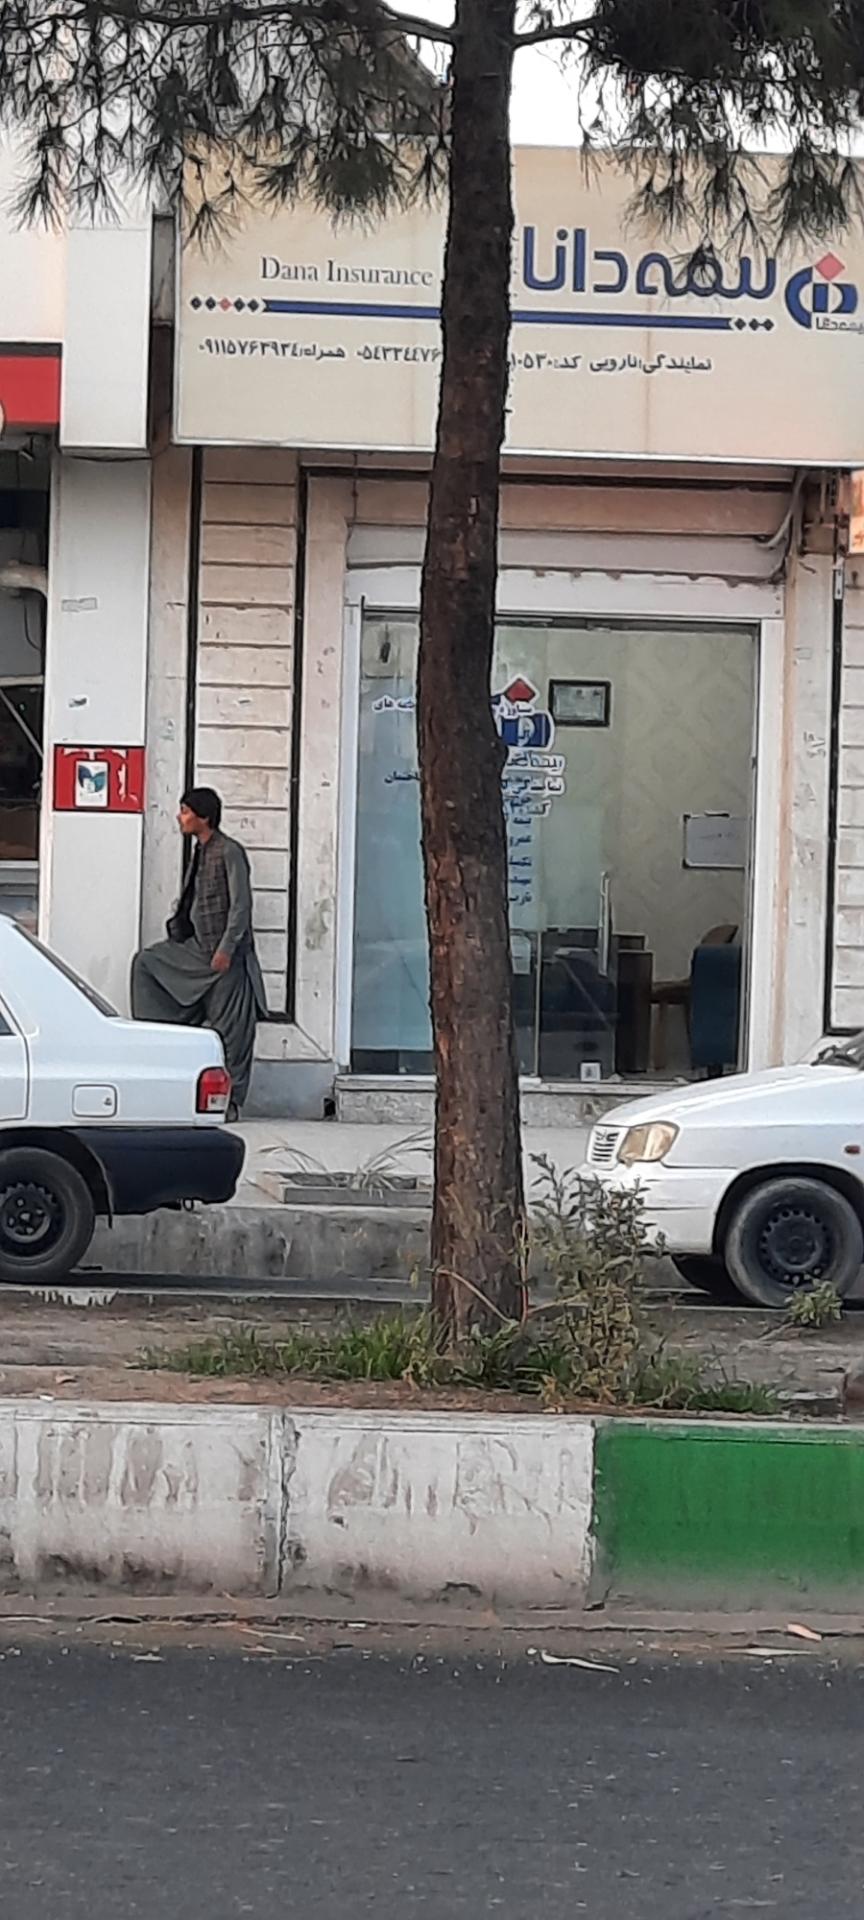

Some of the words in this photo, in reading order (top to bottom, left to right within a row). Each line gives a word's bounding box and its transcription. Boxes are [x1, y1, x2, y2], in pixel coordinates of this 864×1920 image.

[261, 257, 319, 281] Dana
[327, 259, 433, 286] Insurance
[523, 226, 629, 294] دانا
